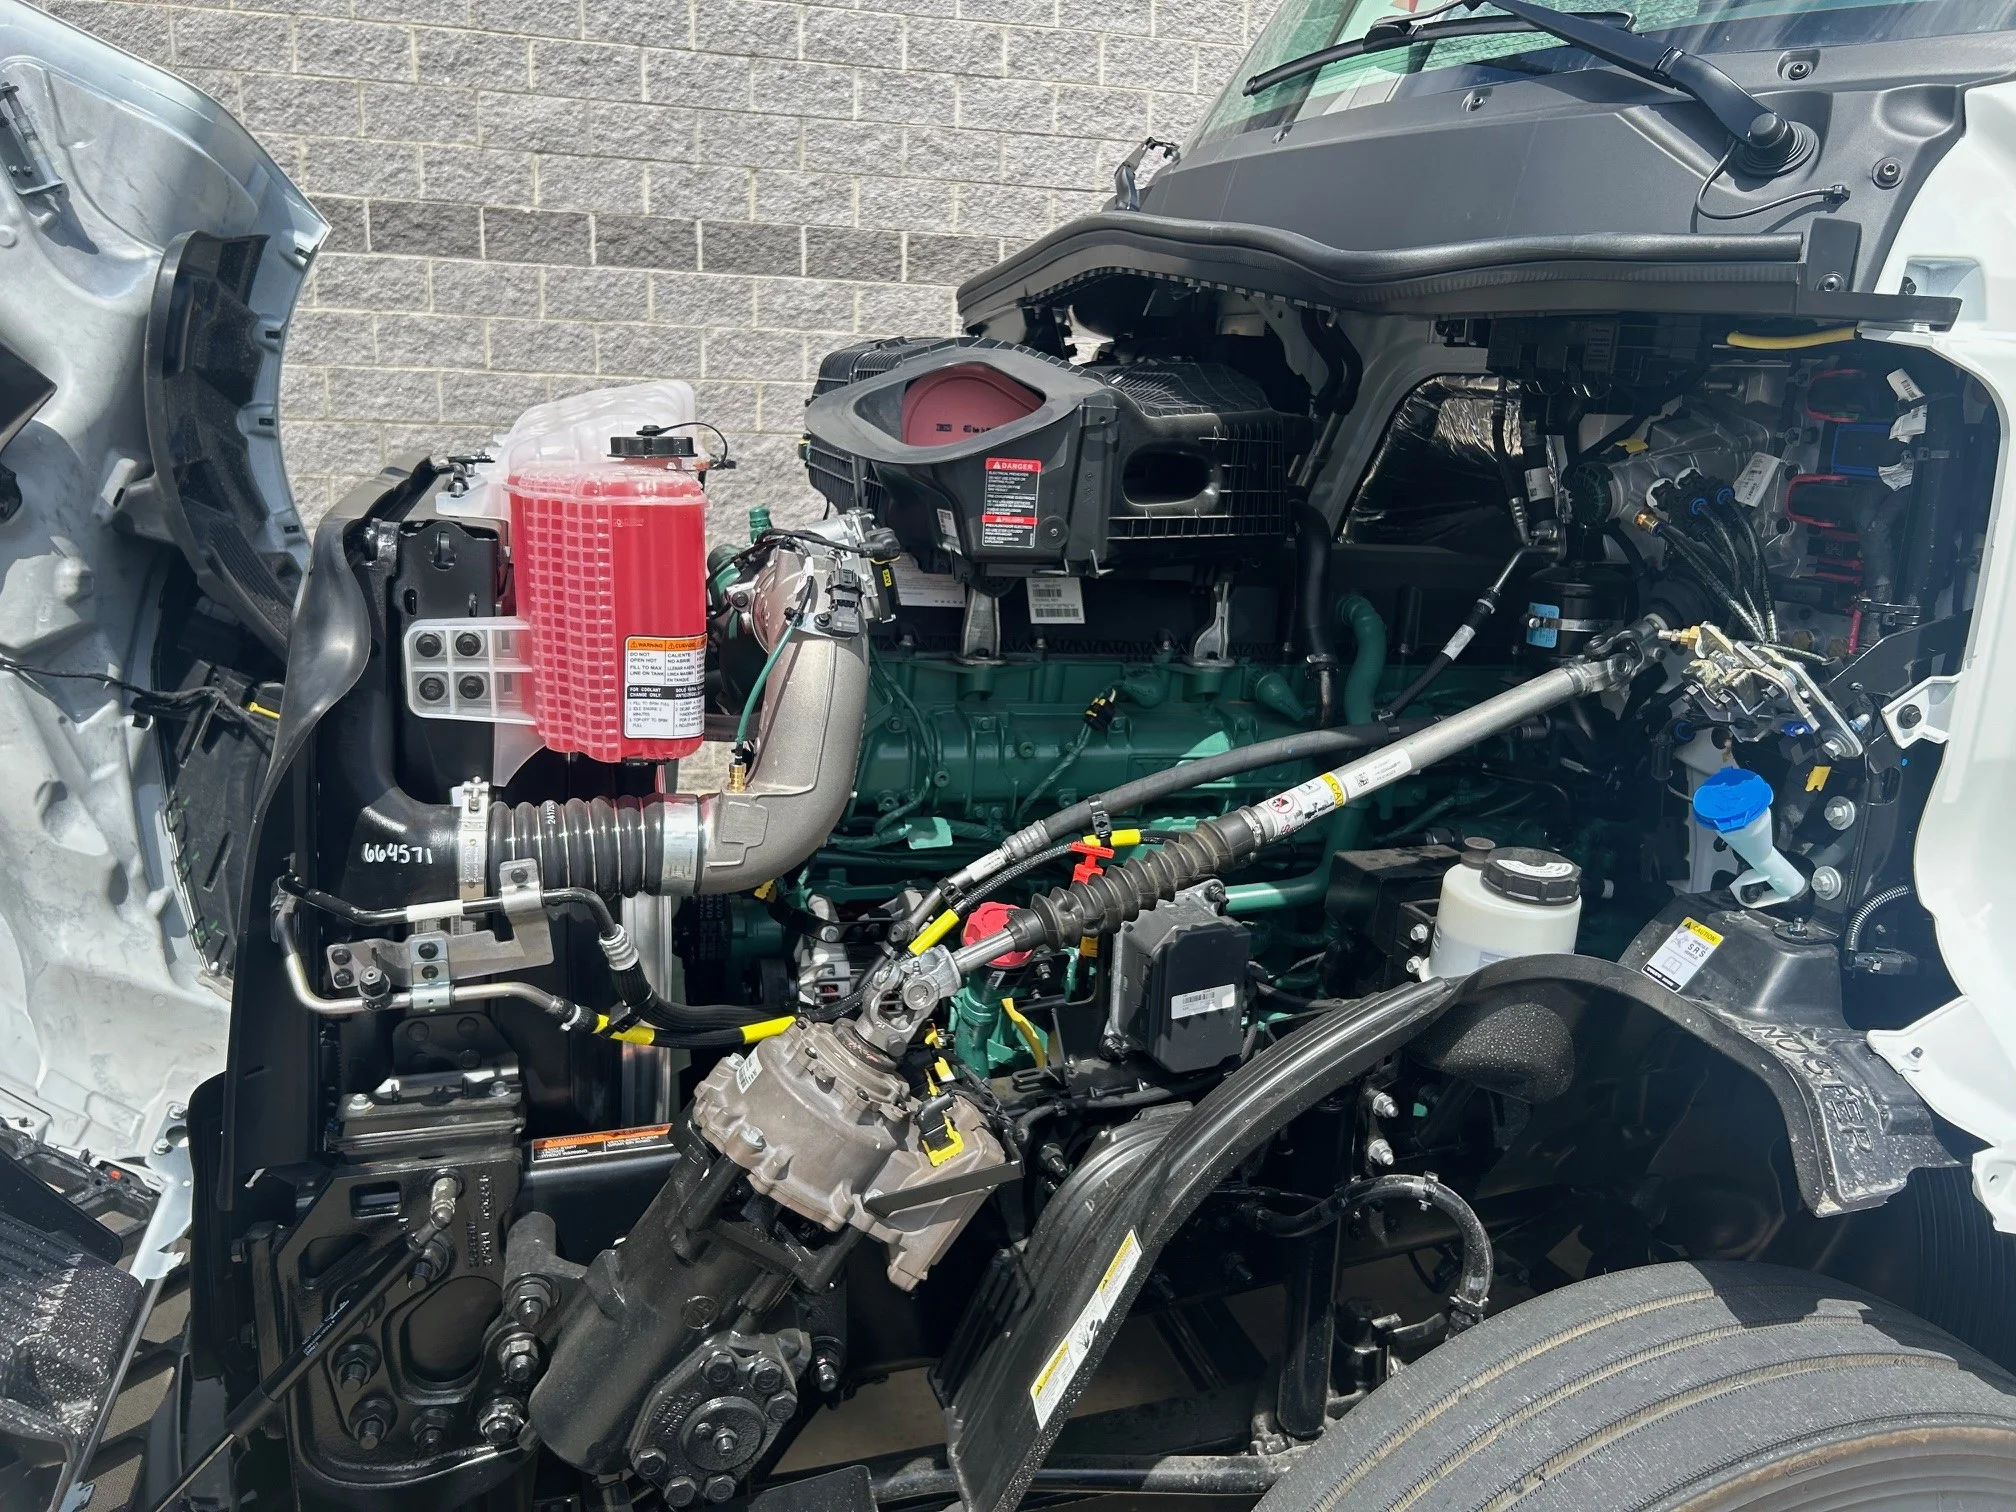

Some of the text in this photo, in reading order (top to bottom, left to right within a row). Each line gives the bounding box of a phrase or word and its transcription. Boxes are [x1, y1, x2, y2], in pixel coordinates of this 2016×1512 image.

[883, 571, 891, 585] 24V
[361, 842, 433, 864] 664571
[1692, 925, 1717, 942] CAUTION
[1750, 1026, 1809, 1054] NO
[1802, 1059, 1875, 1153] STEP
